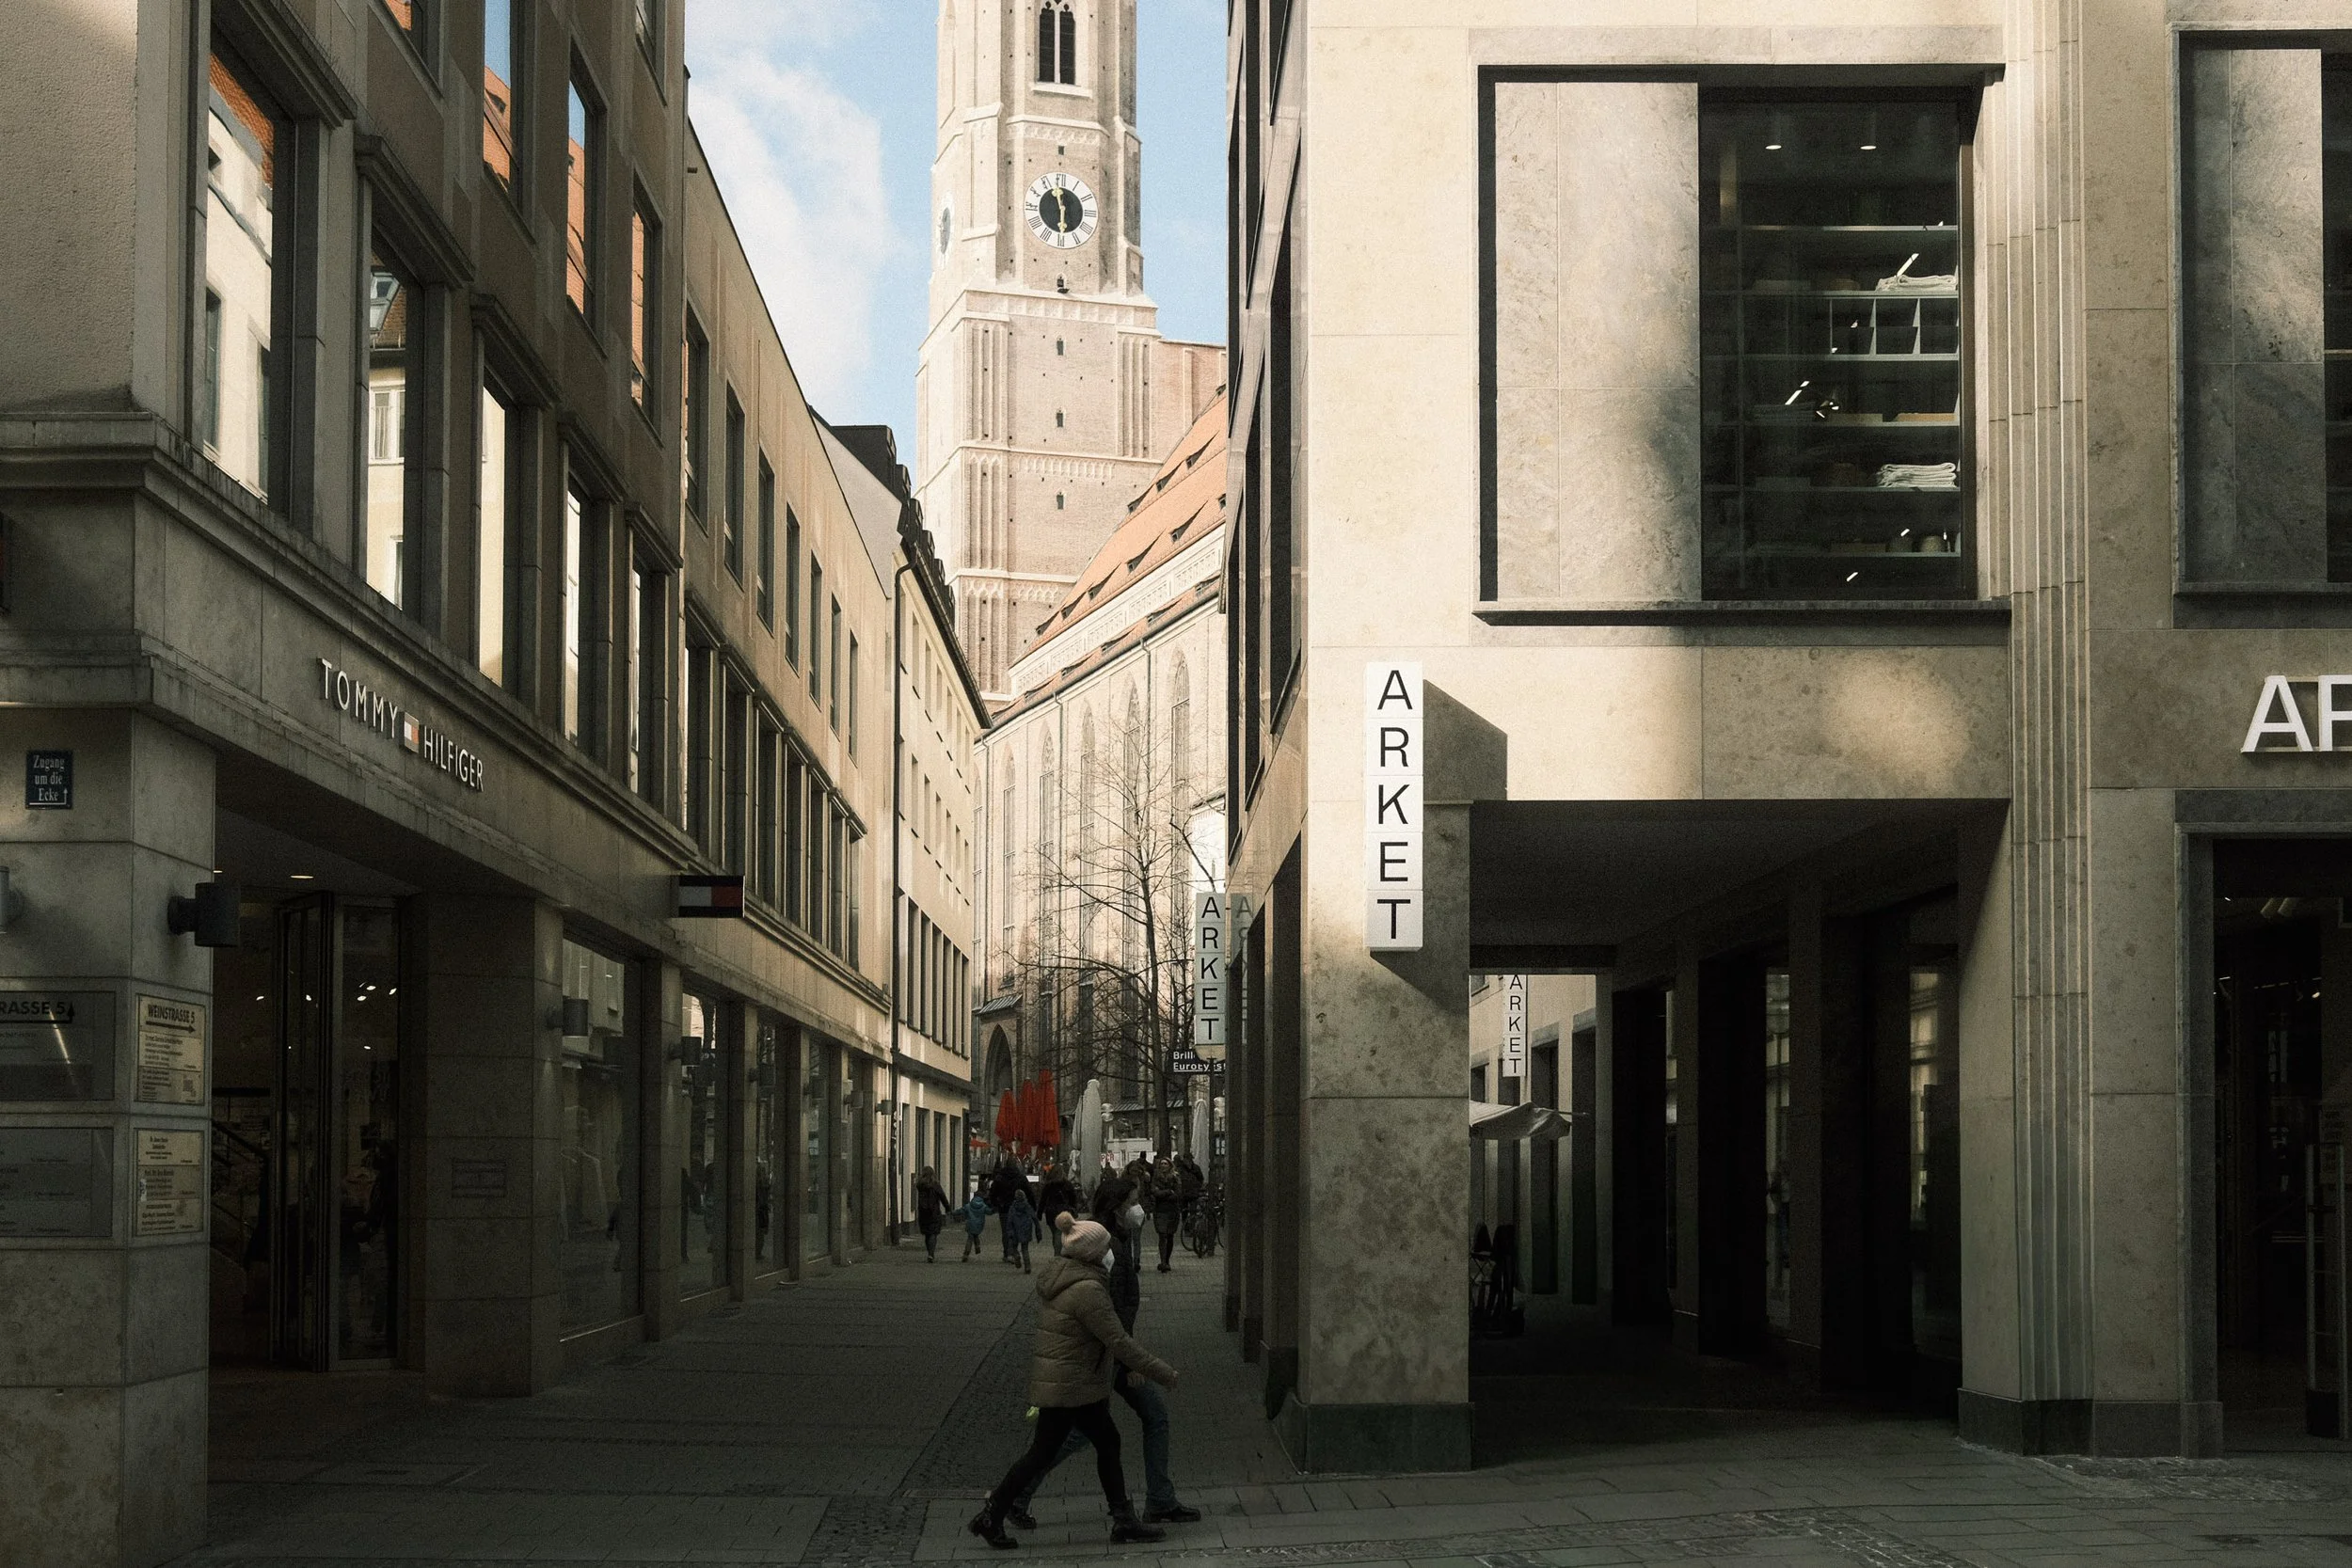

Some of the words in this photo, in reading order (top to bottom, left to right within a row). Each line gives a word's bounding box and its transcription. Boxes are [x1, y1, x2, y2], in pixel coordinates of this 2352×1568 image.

[322, 658, 398, 739] TOMMY
[424, 725, 484, 792] HILFIGER
[33, 754, 65, 772] Zugang
[34, 775, 48, 784] um
[50, 771, 62, 784] die
[39, 787, 58, 801] Ecke
[1376, 670, 1413, 939] ARKET
[1201, 896, 1220, 1039] ARKET
[56, 1001, 66, 1015] 5
[148, 1005, 190, 1023] WEINSTRASSE
[191, 1011, 196, 1024] 5
[1508, 974, 1523, 1073] ARKET
[1173, 1051, 1196, 1060] Brill
